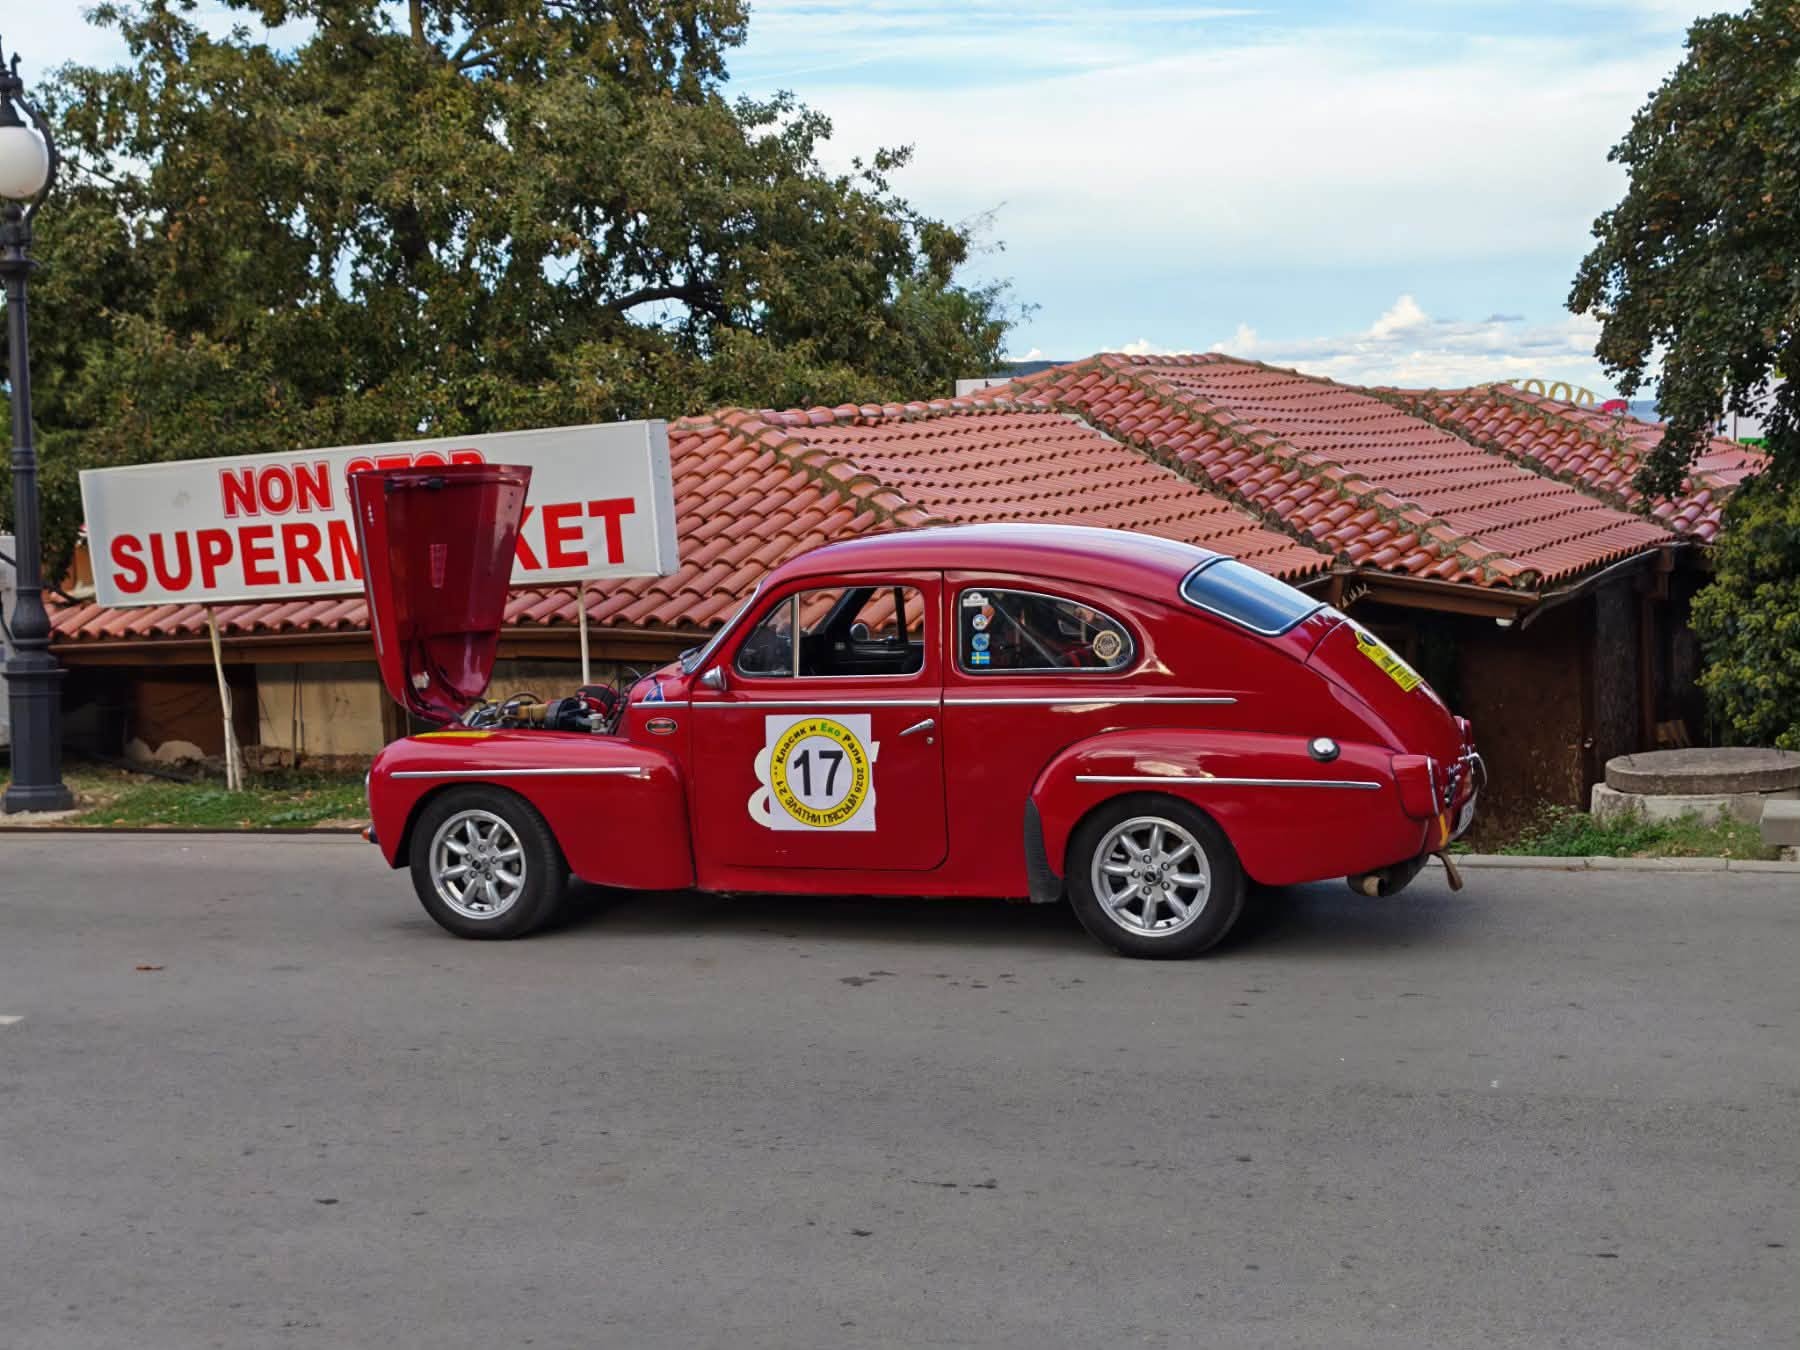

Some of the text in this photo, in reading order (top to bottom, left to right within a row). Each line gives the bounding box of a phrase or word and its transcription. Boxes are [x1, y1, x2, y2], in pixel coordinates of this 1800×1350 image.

[219, 460, 335, 518] NON
[110, 497, 635, 593] SUPERMKET
[776, 727, 807, 764] Класик
[809, 724, 817, 732] и
[820, 722, 841, 737] Еко
[842, 734, 862, 764] Рали
[793, 749, 844, 796] 17
